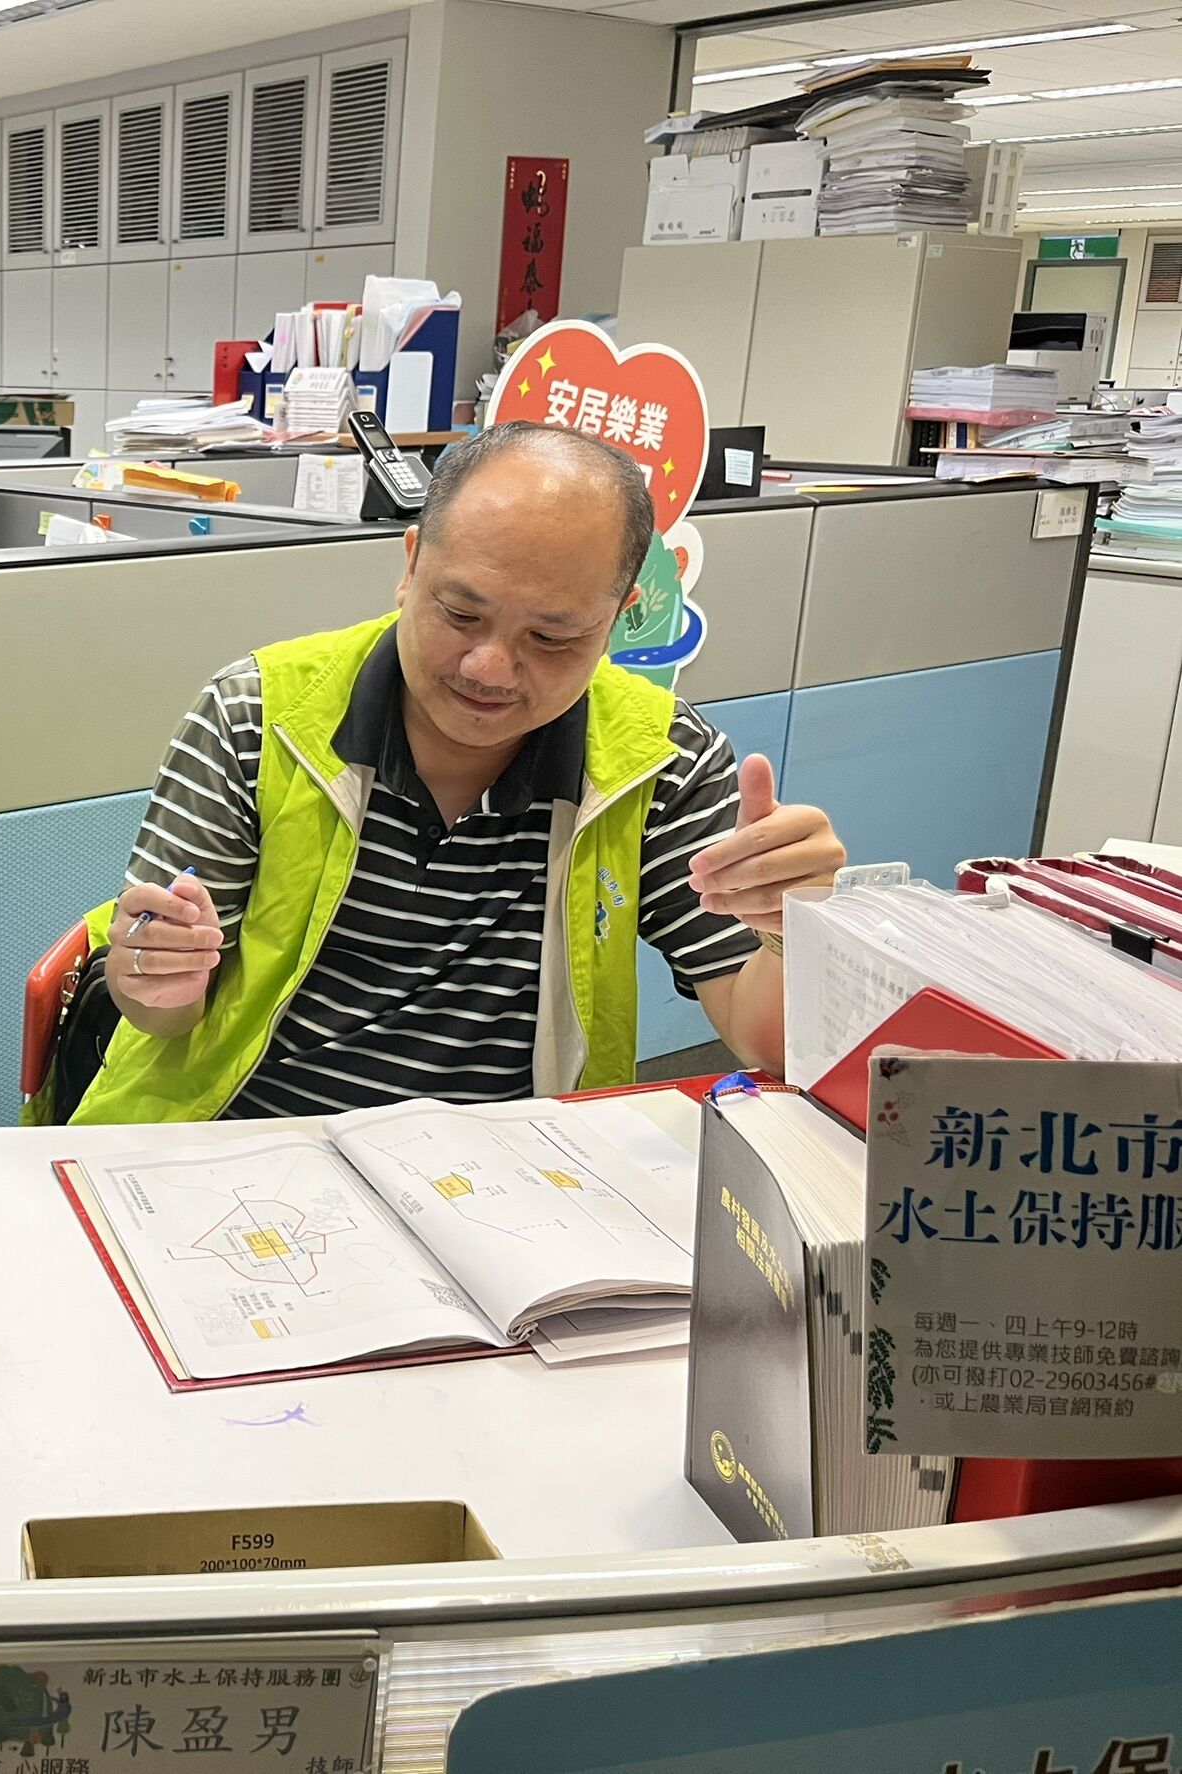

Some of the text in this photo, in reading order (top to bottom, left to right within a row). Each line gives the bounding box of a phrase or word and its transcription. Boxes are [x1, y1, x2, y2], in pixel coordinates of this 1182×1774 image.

[543, 378, 669, 451] 安居樂業
[923, 1105, 1182, 1178] 新北市
[874, 1187, 1182, 1250] 水土保持服
[914, 1312, 1139, 1342] 每週一、四上午9-12時
[231, 1533, 275, 1551] F599
[82, 1667, 342, 1689] 新北市水土保持服務團
[100, 1702, 302, 1758] 陳盈男
[304, 1755, 355, 1774] 技師
